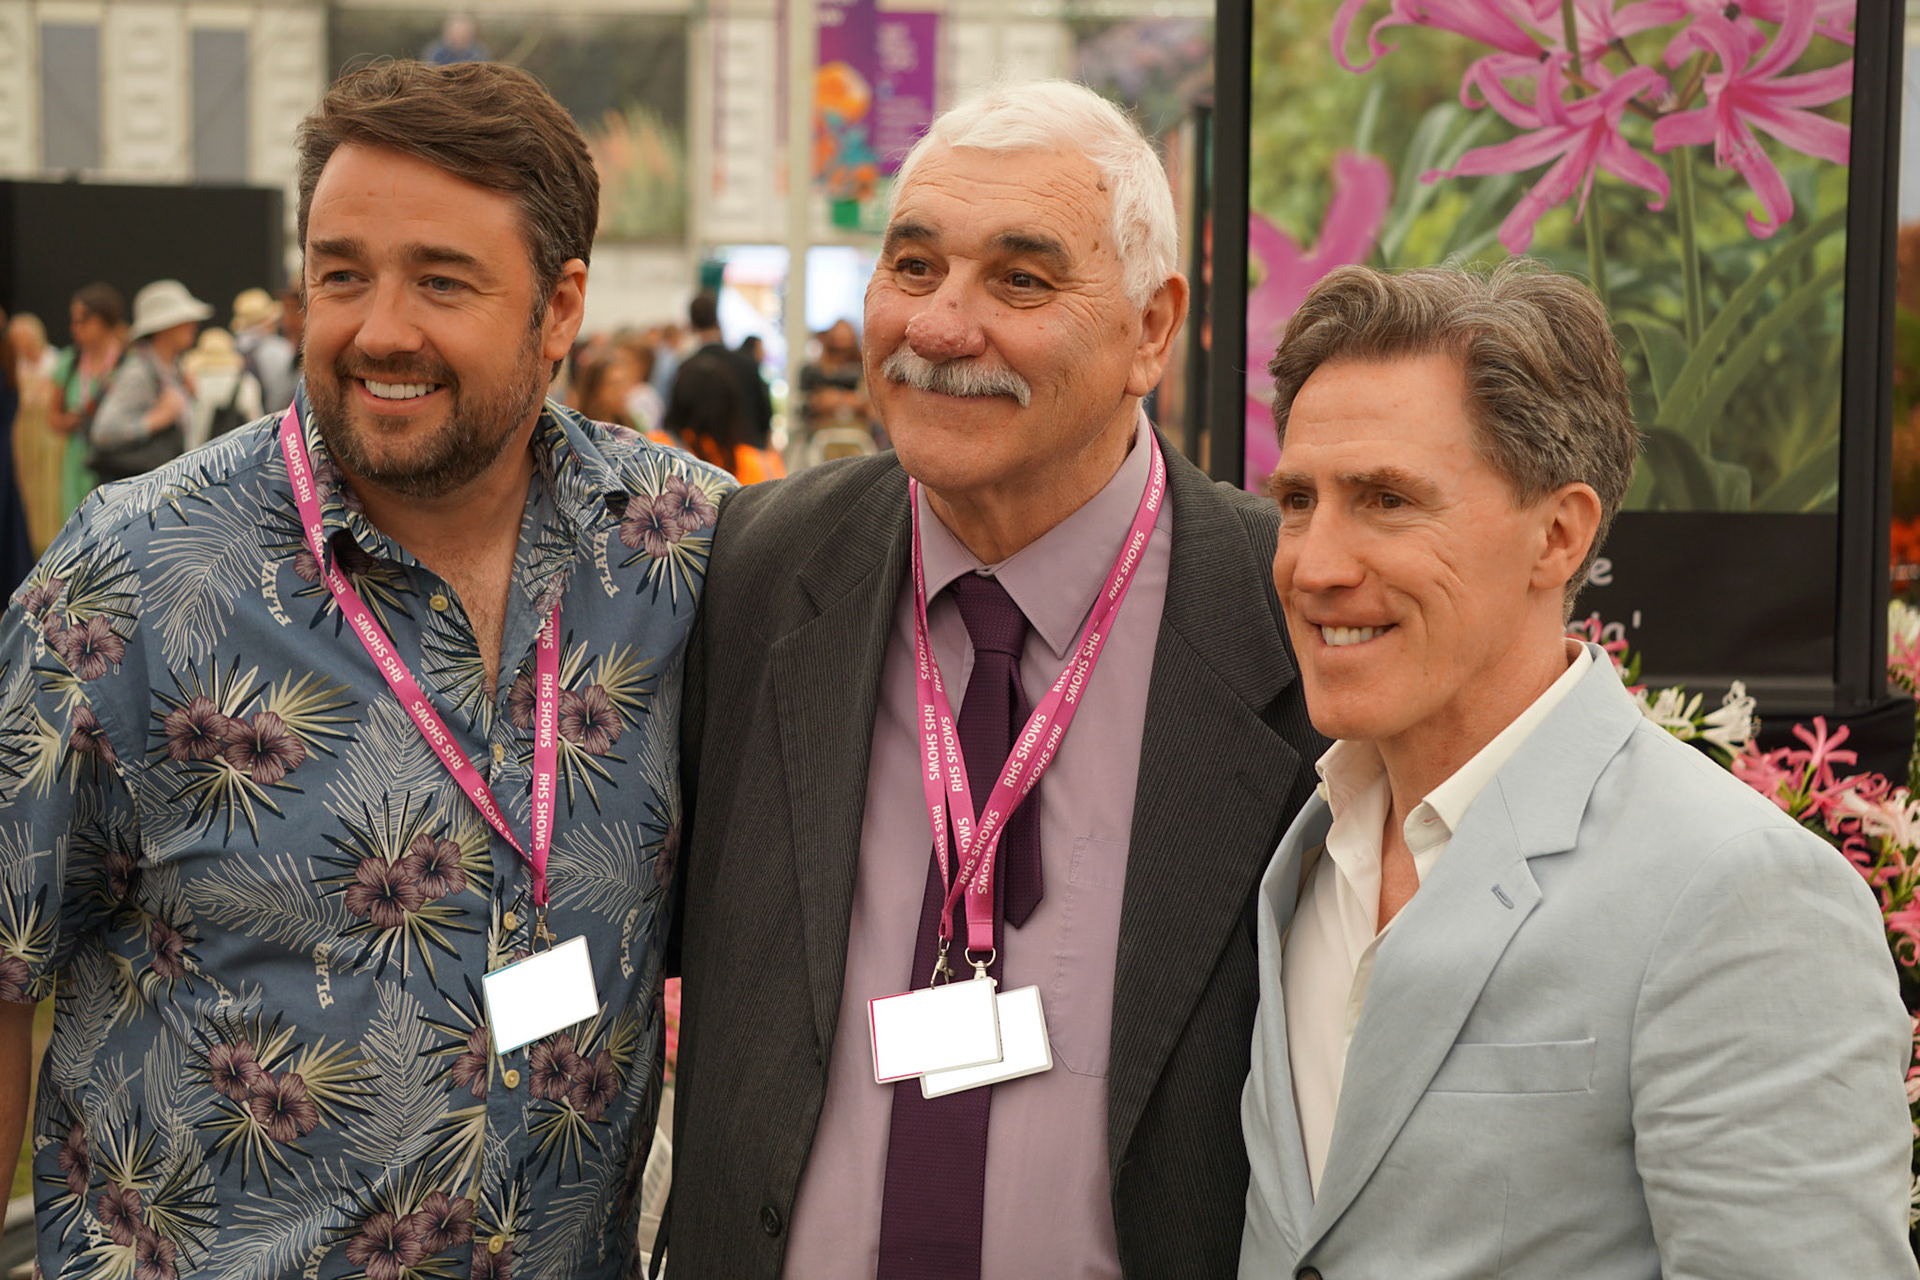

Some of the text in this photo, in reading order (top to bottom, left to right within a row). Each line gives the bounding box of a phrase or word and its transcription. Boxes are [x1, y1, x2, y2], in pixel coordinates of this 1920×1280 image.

[286, 432, 311, 503] RHS SHOWS
[1146, 486, 1160, 512] RHS
[261, 560, 292, 627] PLAYA
[310, 524, 346, 595] RHS OWS
[593, 532, 620, 598] PLAYA
[1108, 530, 1145, 600] RHS SHOWS
[354, 612, 404, 683] RHS SHOWS
[1082, 632, 1101, 658] RHS
[540, 673, 553, 748] RHS SHOWS
[1052, 669, 1070, 692] RHS
[1065, 658, 1089, 704] SHOWS
[411, 701, 464, 770] RHS SHOWS
[924, 704, 940, 780] RHS SHOWS
[940, 716, 963, 792] RHS SHOWS
[1003, 713, 1046, 788] RHS SHOWS
[1022, 724, 1062, 795] RHS SHOWS
[473, 787, 505, 831] SHOWS
[535, 773, 550, 851] RHS SHOWS
[932, 804, 942, 832] RHS
[957, 817, 972, 853] OWS
[960, 858, 975, 885] RHS
[971, 809, 1000, 858] SHOWS
[977, 845, 994, 895] SHOWS
